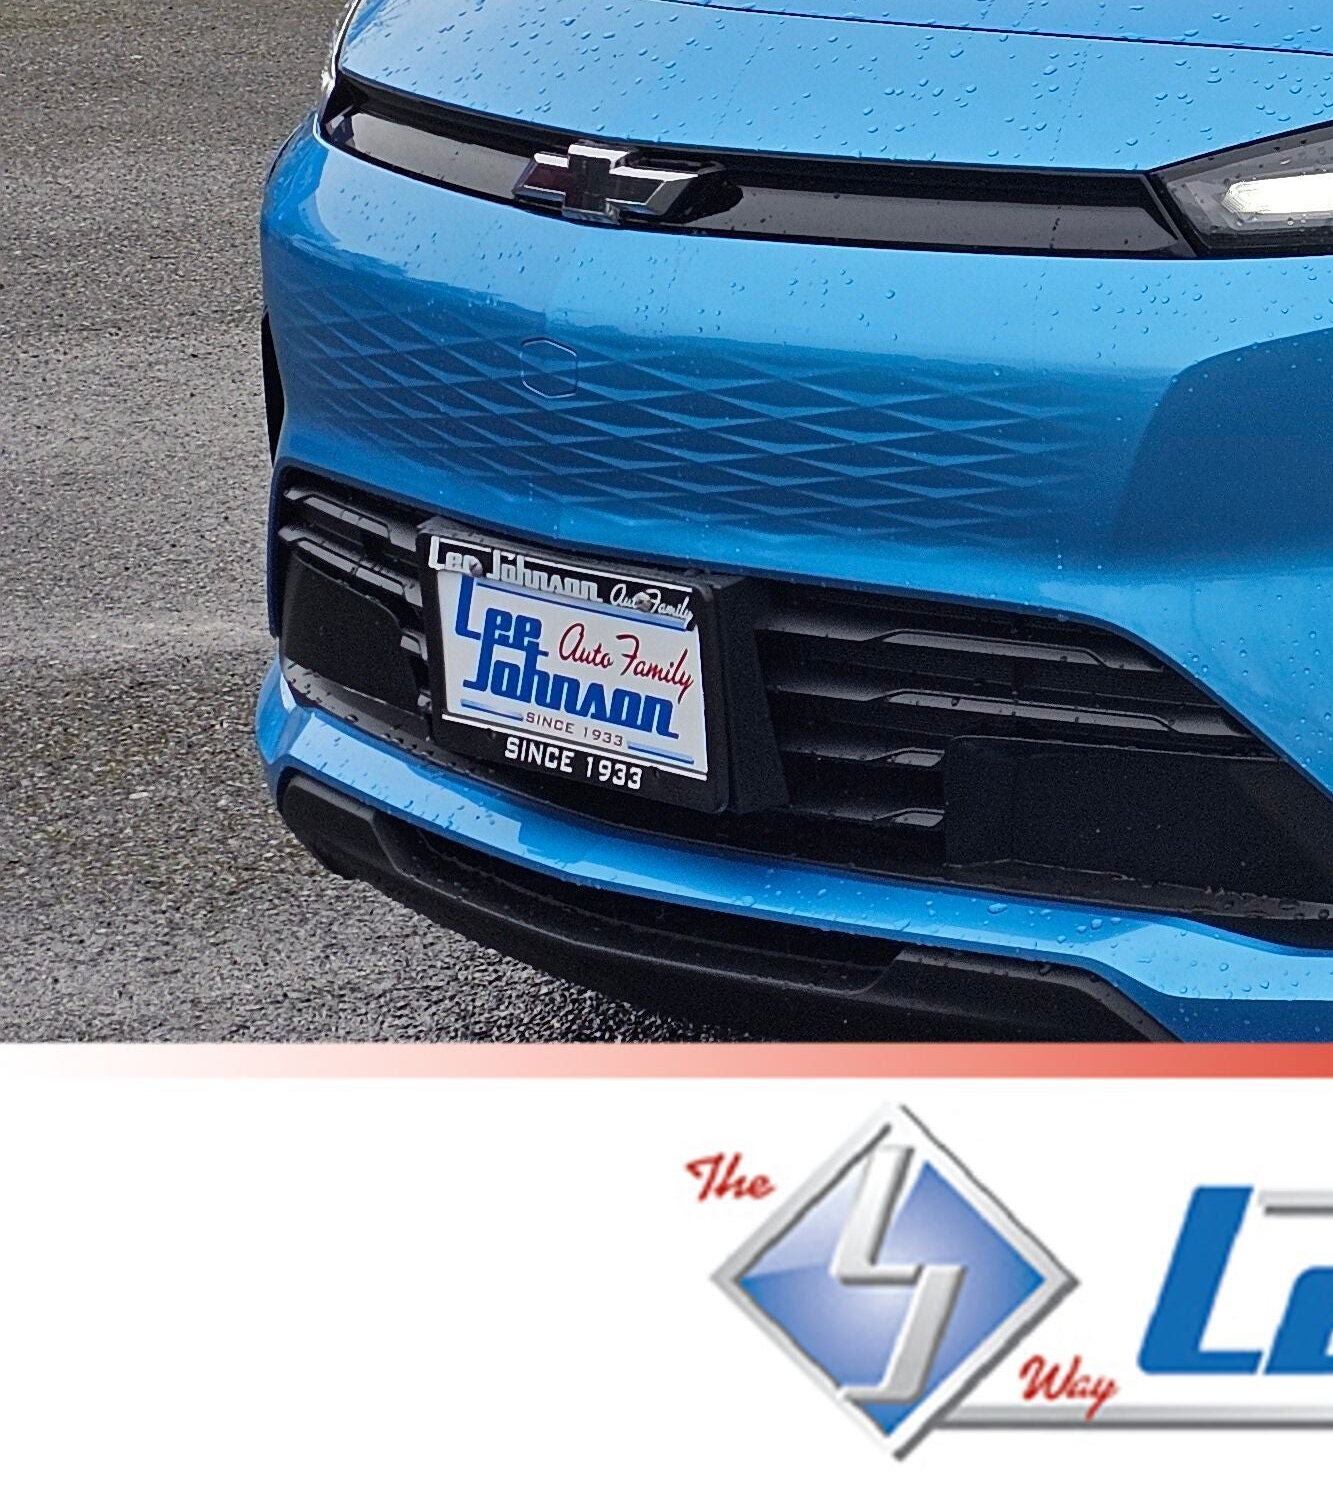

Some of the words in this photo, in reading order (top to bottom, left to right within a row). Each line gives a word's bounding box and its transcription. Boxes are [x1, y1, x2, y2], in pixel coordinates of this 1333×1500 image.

[486, 549, 603, 602] Johnson
[455, 576, 549, 658] Lee
[558, 622, 614, 670] Auto
[616, 633, 694, 705] Family
[462, 640, 680, 739] Johnson
[525, 711, 575, 736] SINCE
[582, 726, 624, 748] 1933
[504, 736, 575, 773] SINCE
[586, 760, 643, 791] 1933
